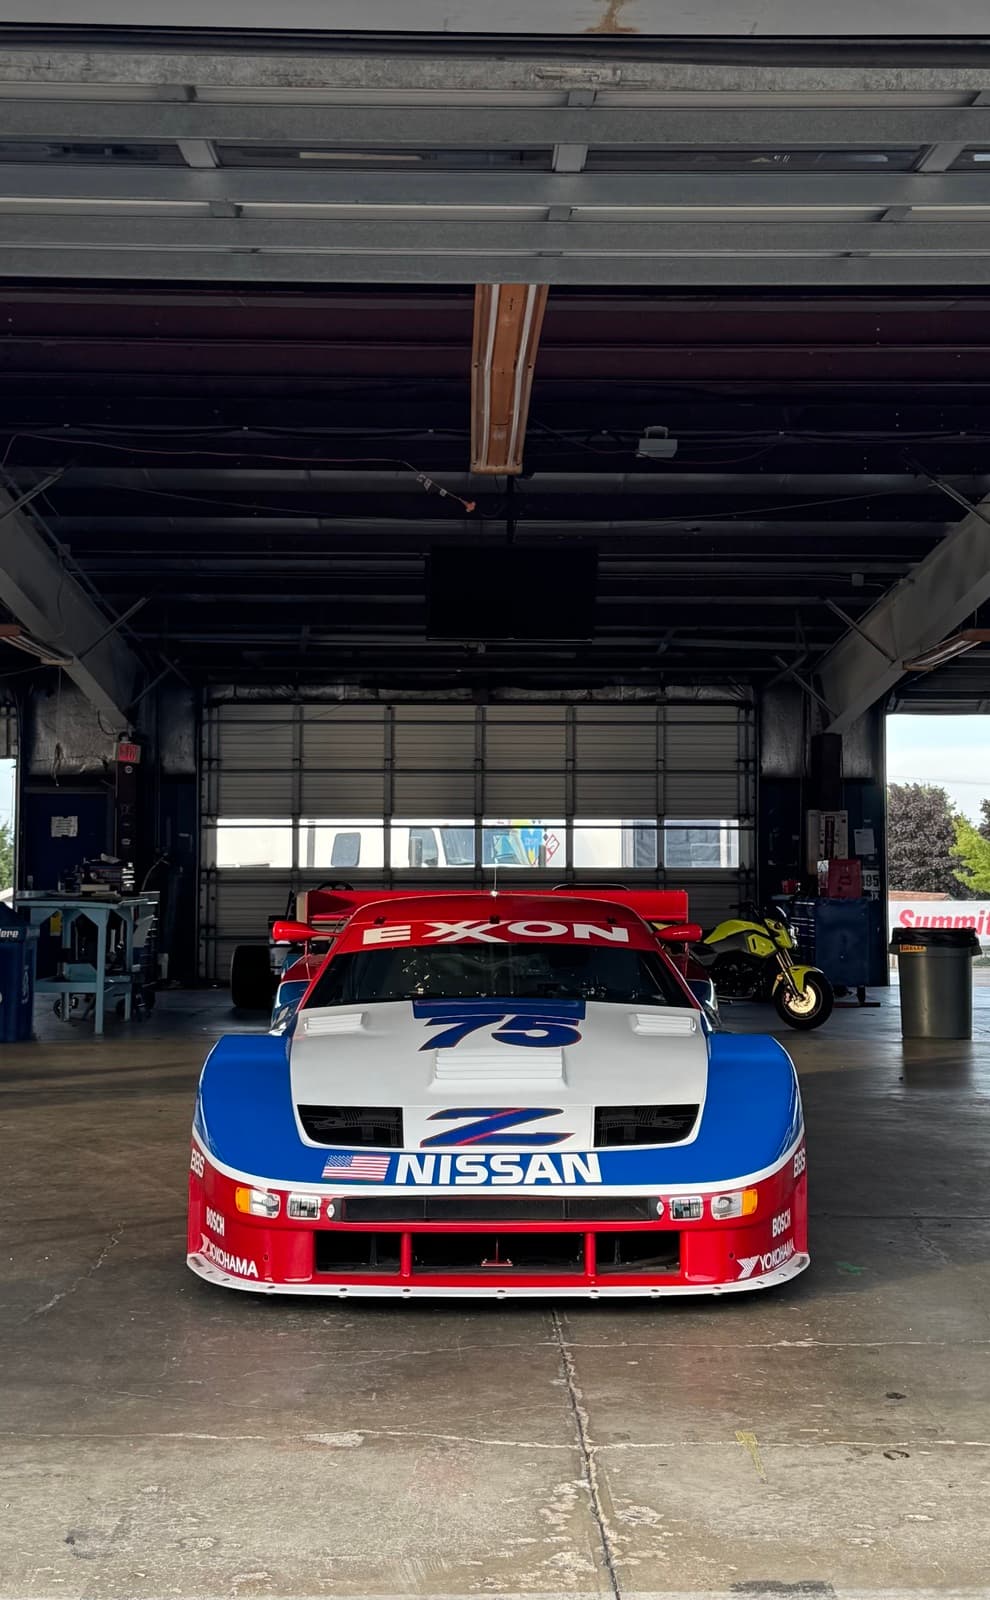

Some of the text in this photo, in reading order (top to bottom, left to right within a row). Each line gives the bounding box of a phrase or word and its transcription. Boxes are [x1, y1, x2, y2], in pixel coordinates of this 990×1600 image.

[0, 928, 19, 938] ere
[362, 920, 629, 945] EXXON
[899, 909, 990, 935] Summit
[418, 1014, 582, 1051] 75
[190, 1148, 205, 1178] BBS
[395, 1153, 603, 1184] NISSAN
[794, 1148, 805, 1178] BBS
[206, 1206, 225, 1236] BOSCH
[772, 1208, 791, 1238] BOSCH
[208, 1243, 259, 1278] YOKOHAMA
[760, 1237, 796, 1271] YOKOHAMA
